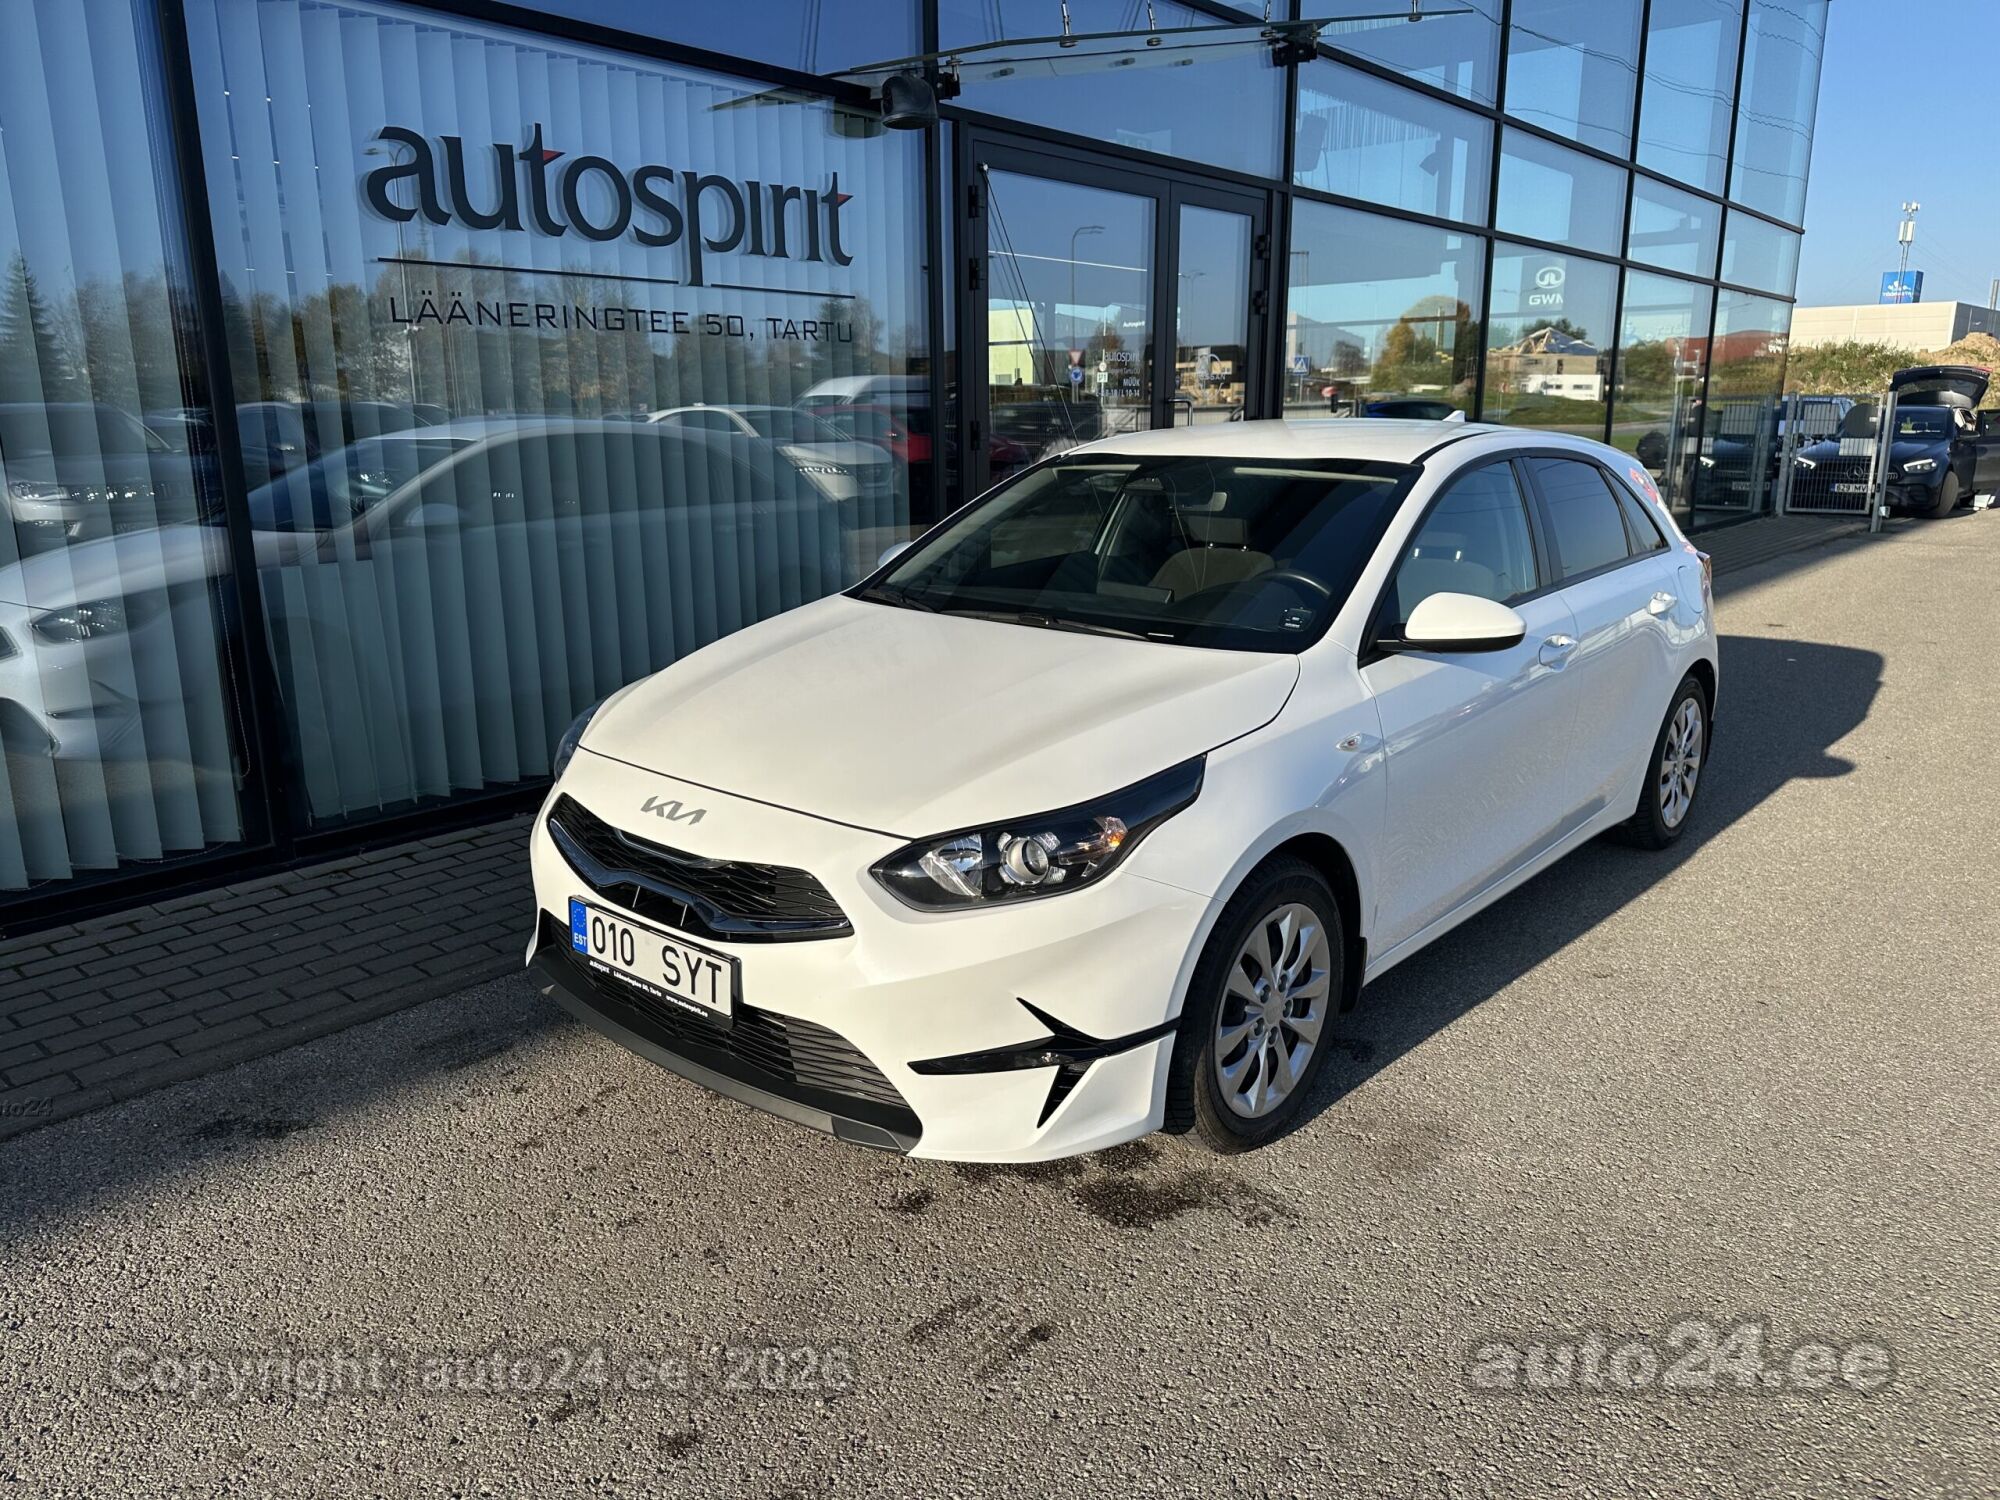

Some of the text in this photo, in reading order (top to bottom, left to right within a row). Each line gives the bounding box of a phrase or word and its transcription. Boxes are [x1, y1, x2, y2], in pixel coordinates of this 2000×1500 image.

[366, 122, 854, 287] autospirit
[389, 291, 853, 343] LÄÄNERINGTEE 50, TARTU
[640, 796, 707, 825] KIA
[574, 932, 588, 947] EST
[592, 915, 722, 1004] 010 SYT
